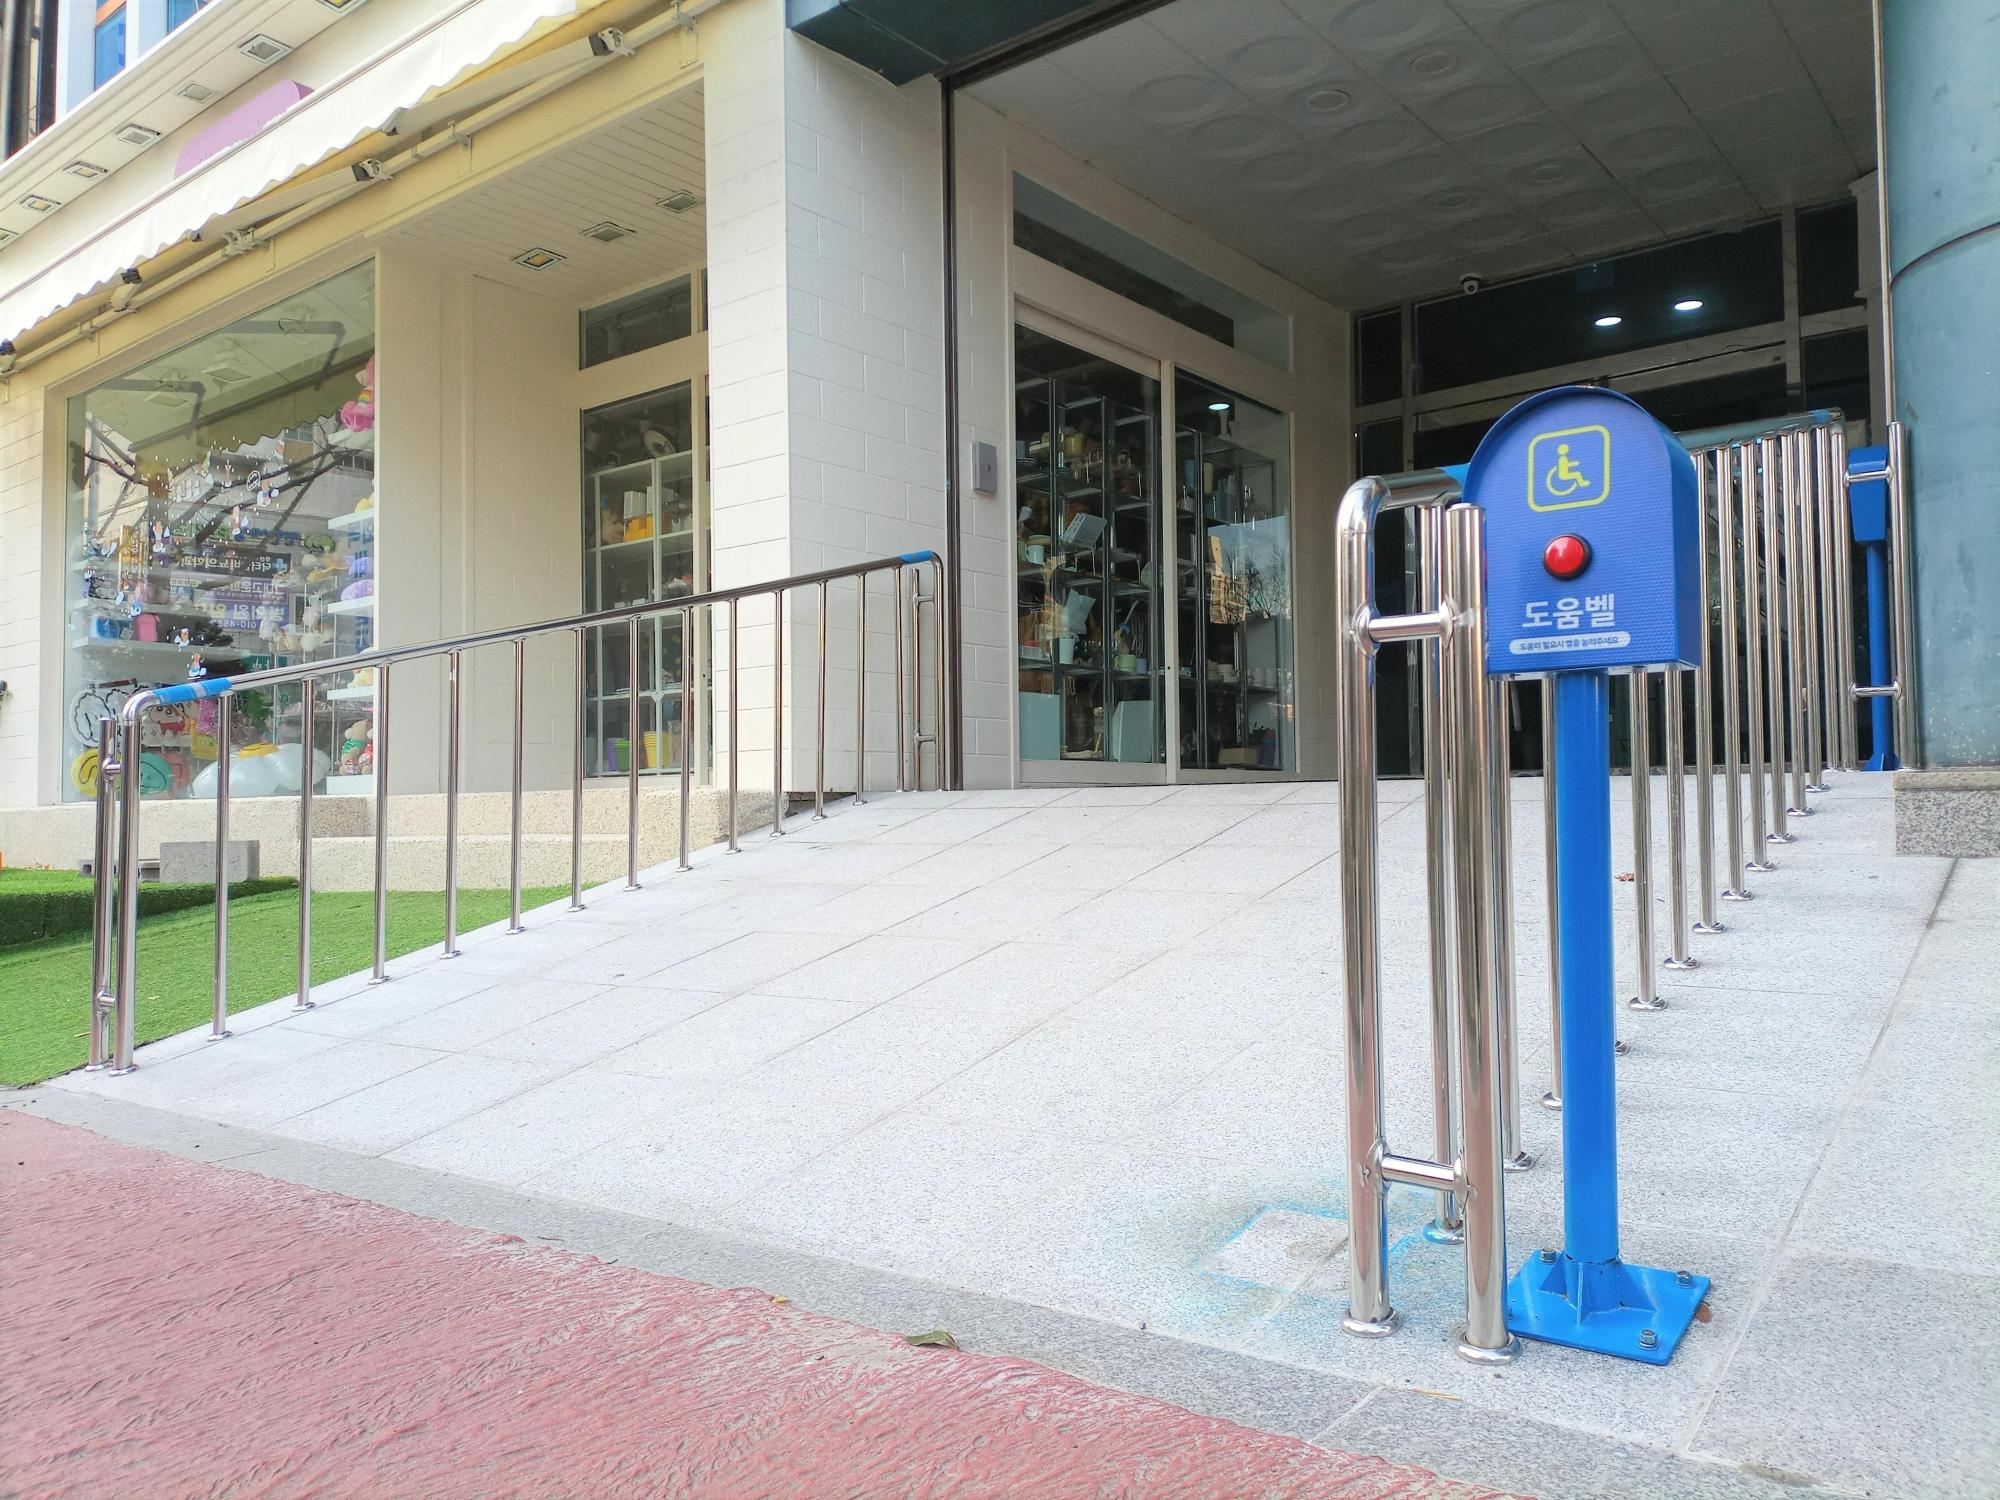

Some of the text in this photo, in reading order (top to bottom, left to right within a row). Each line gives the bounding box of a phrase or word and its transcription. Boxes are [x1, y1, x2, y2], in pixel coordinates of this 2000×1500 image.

[1522, 593, 1616, 630] 도움벨
[1543, 640, 1564, 650] 필요시
[1582, 635, 1619, 647] 눌러주세요
